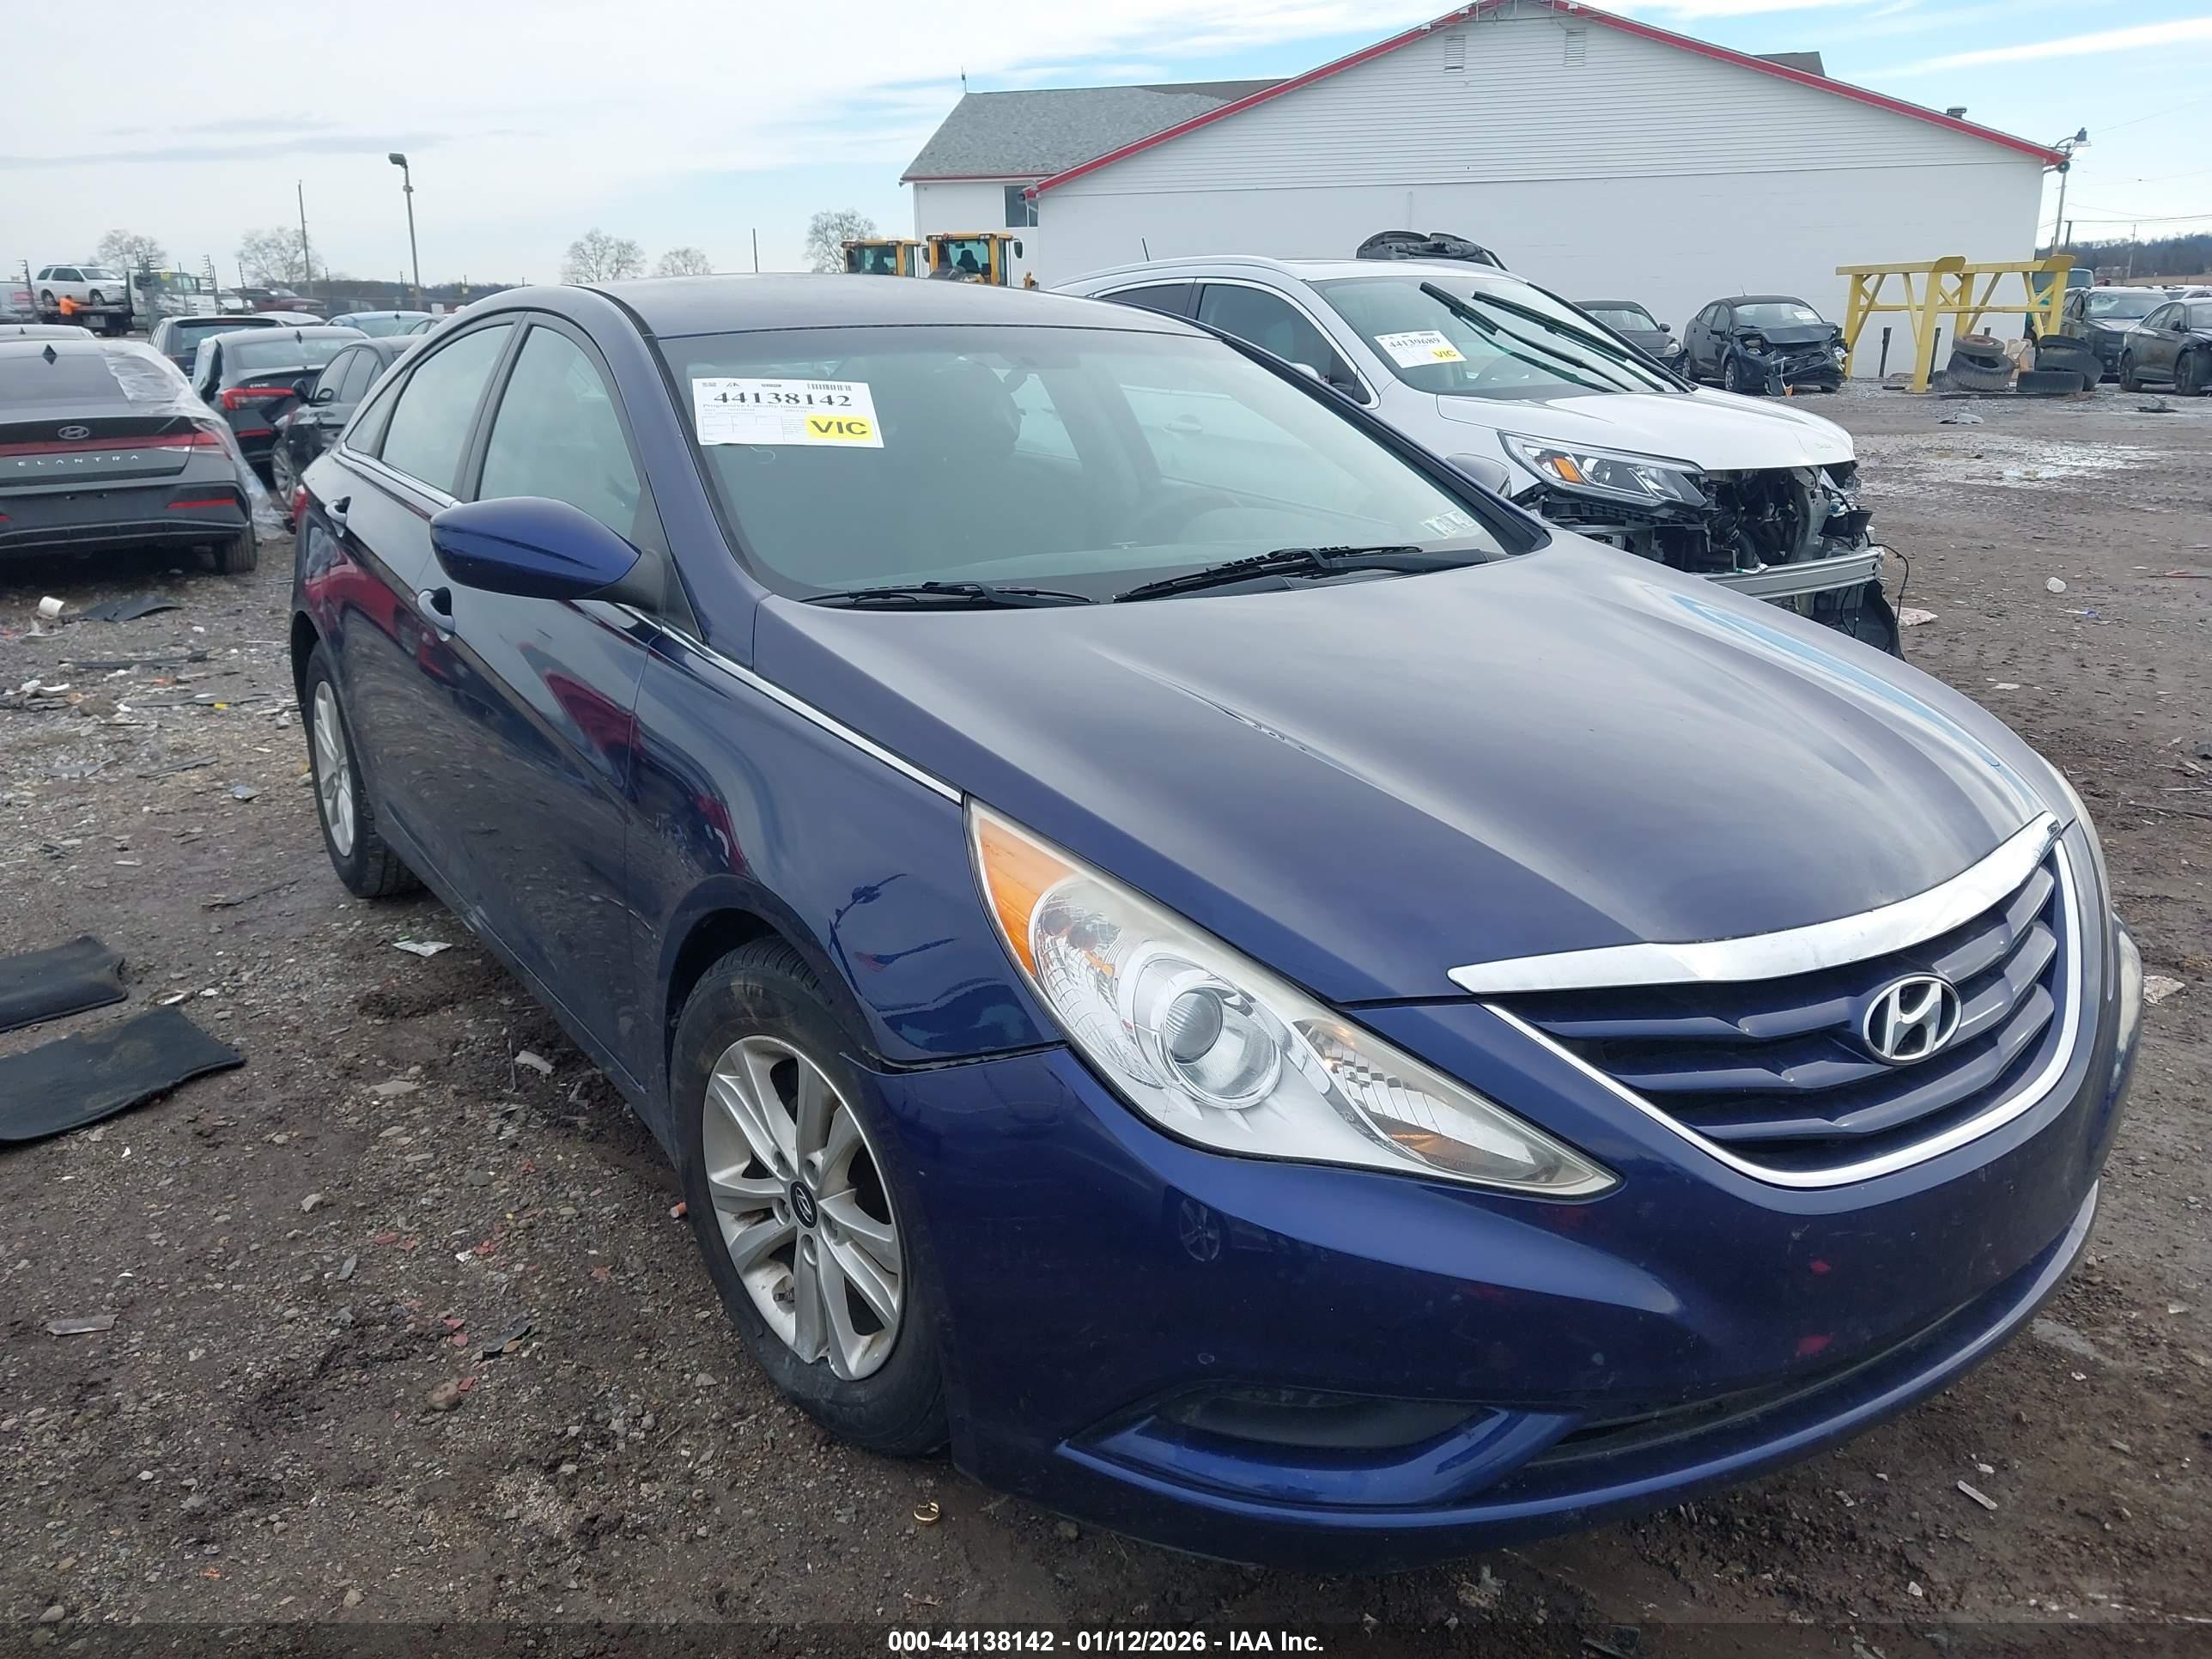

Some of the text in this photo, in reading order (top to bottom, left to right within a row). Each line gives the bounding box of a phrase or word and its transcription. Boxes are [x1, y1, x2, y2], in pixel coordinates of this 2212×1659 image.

[1431, 349, 1457, 358] VIC
[714, 392, 852, 407] 44138142
[810, 420, 868, 435] VIC
[17, 454, 140, 466] ELANTRA
